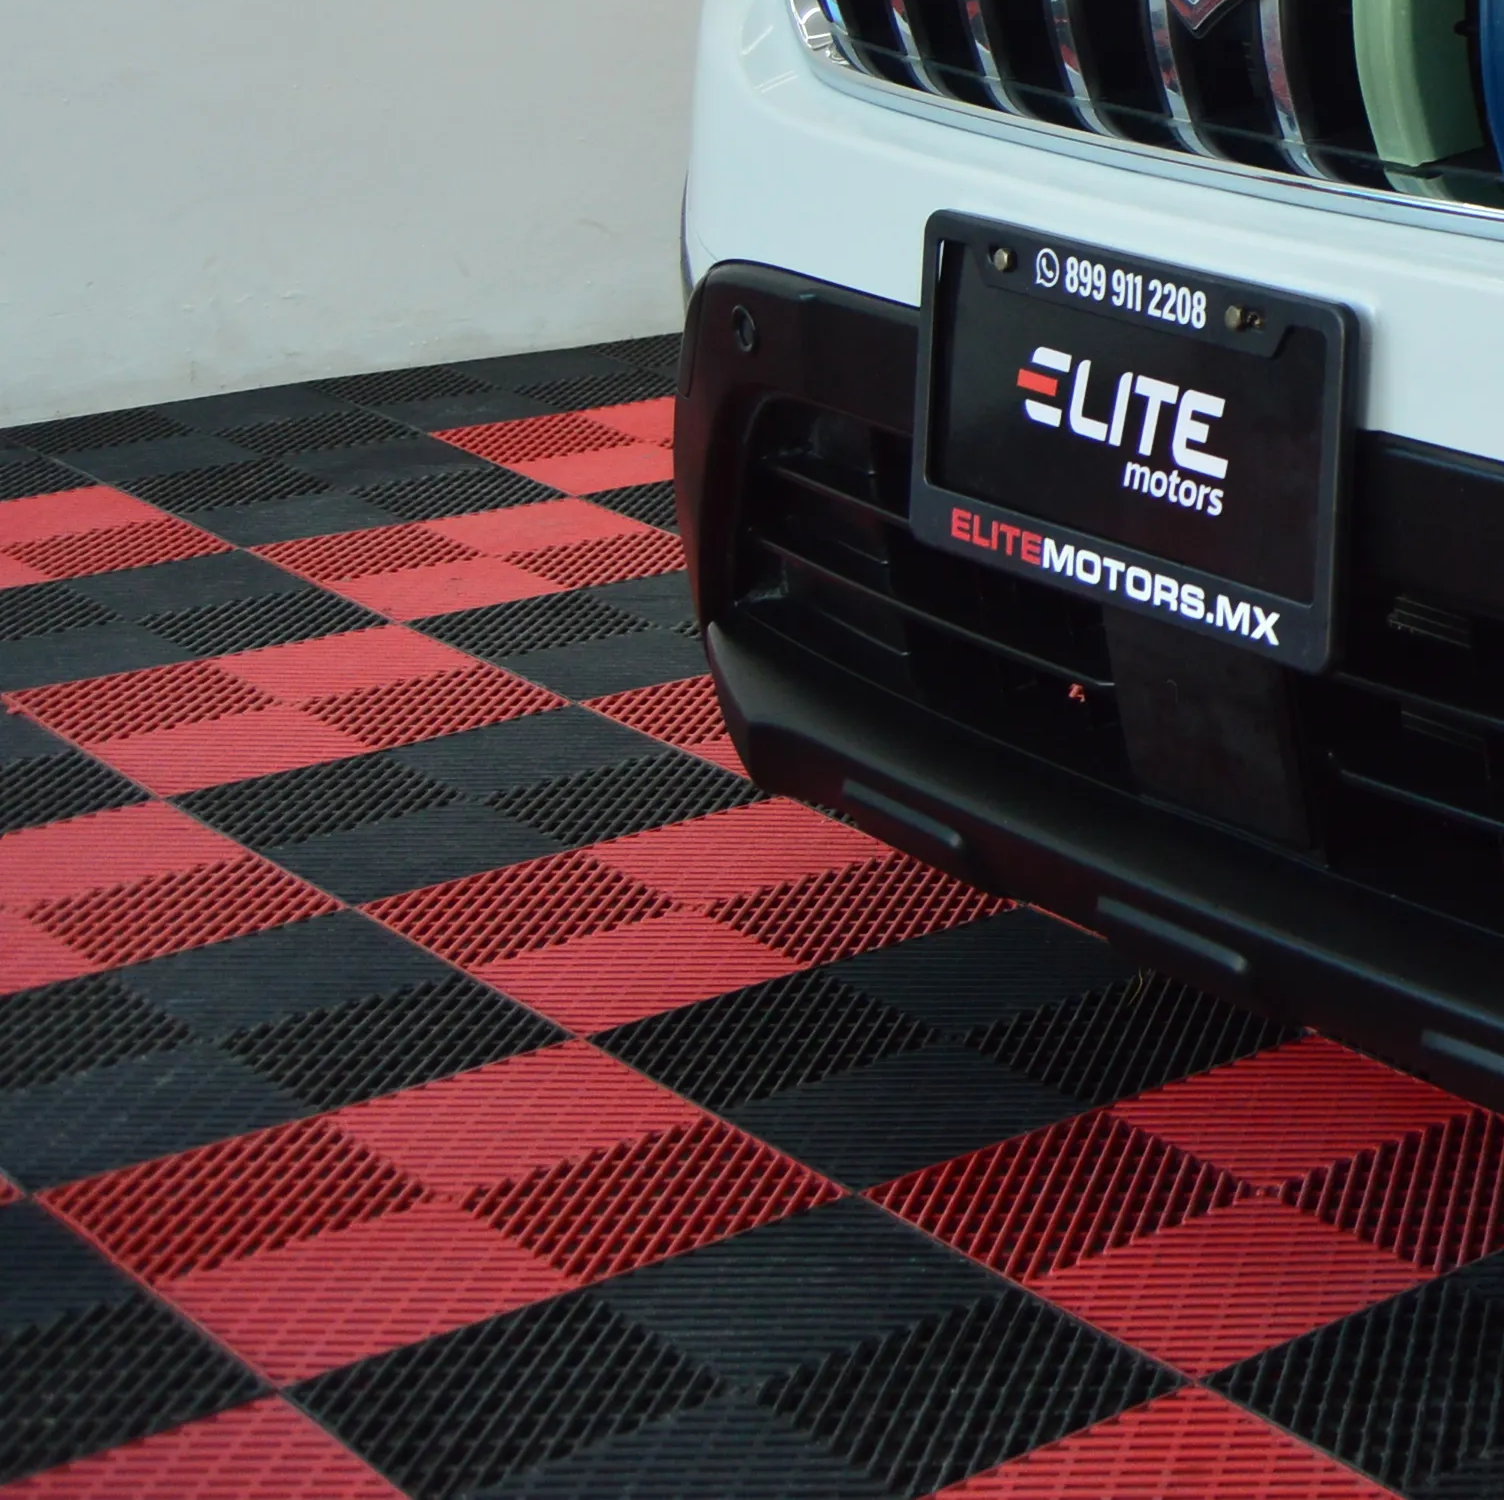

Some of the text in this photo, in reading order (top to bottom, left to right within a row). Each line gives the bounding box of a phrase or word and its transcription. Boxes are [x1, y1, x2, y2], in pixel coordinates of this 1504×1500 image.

[1065, 256, 1207, 329] 899 911 2208
[1017, 346, 1228, 479] ELITE
[1123, 461, 1224, 516] motors
[951, 508, 1280, 646] ELITEMOTORS.MX
